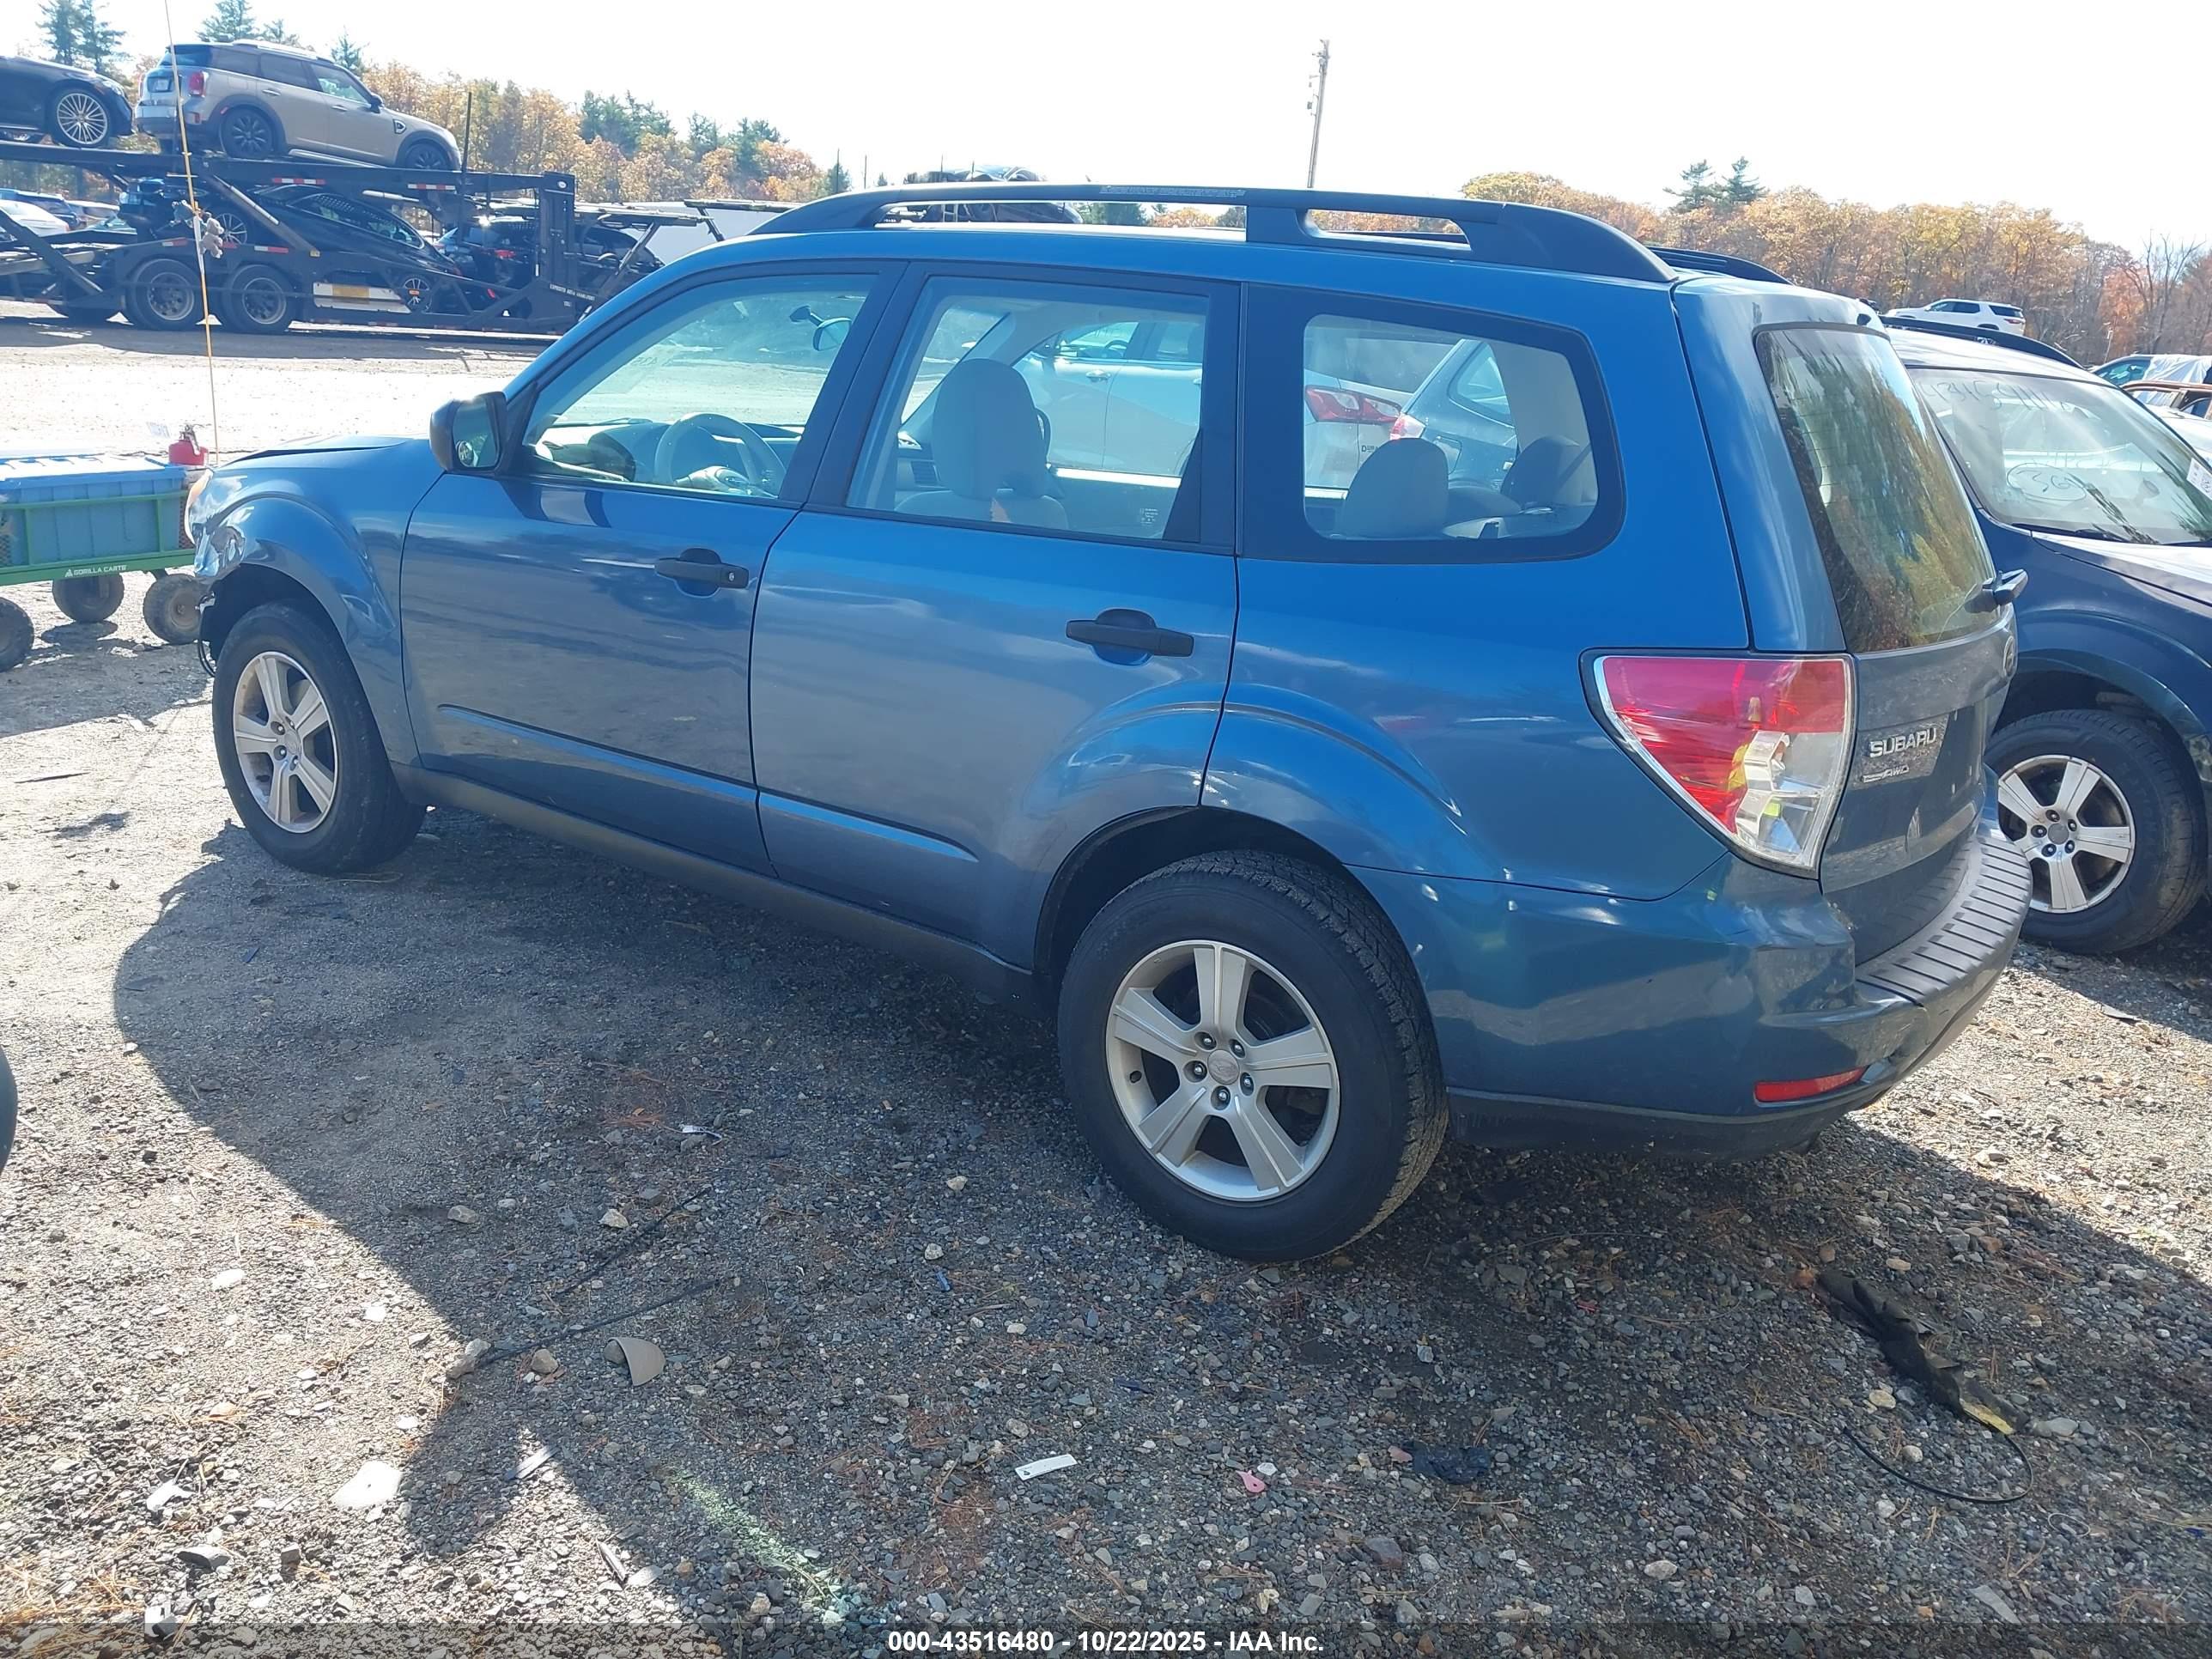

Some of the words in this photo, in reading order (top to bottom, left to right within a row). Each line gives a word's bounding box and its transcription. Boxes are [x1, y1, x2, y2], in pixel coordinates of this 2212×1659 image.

[73, 567, 102, 575] GORILLA
[1869, 727, 1936, 757] SUBARU
[1882, 764, 1909, 778] AWD
